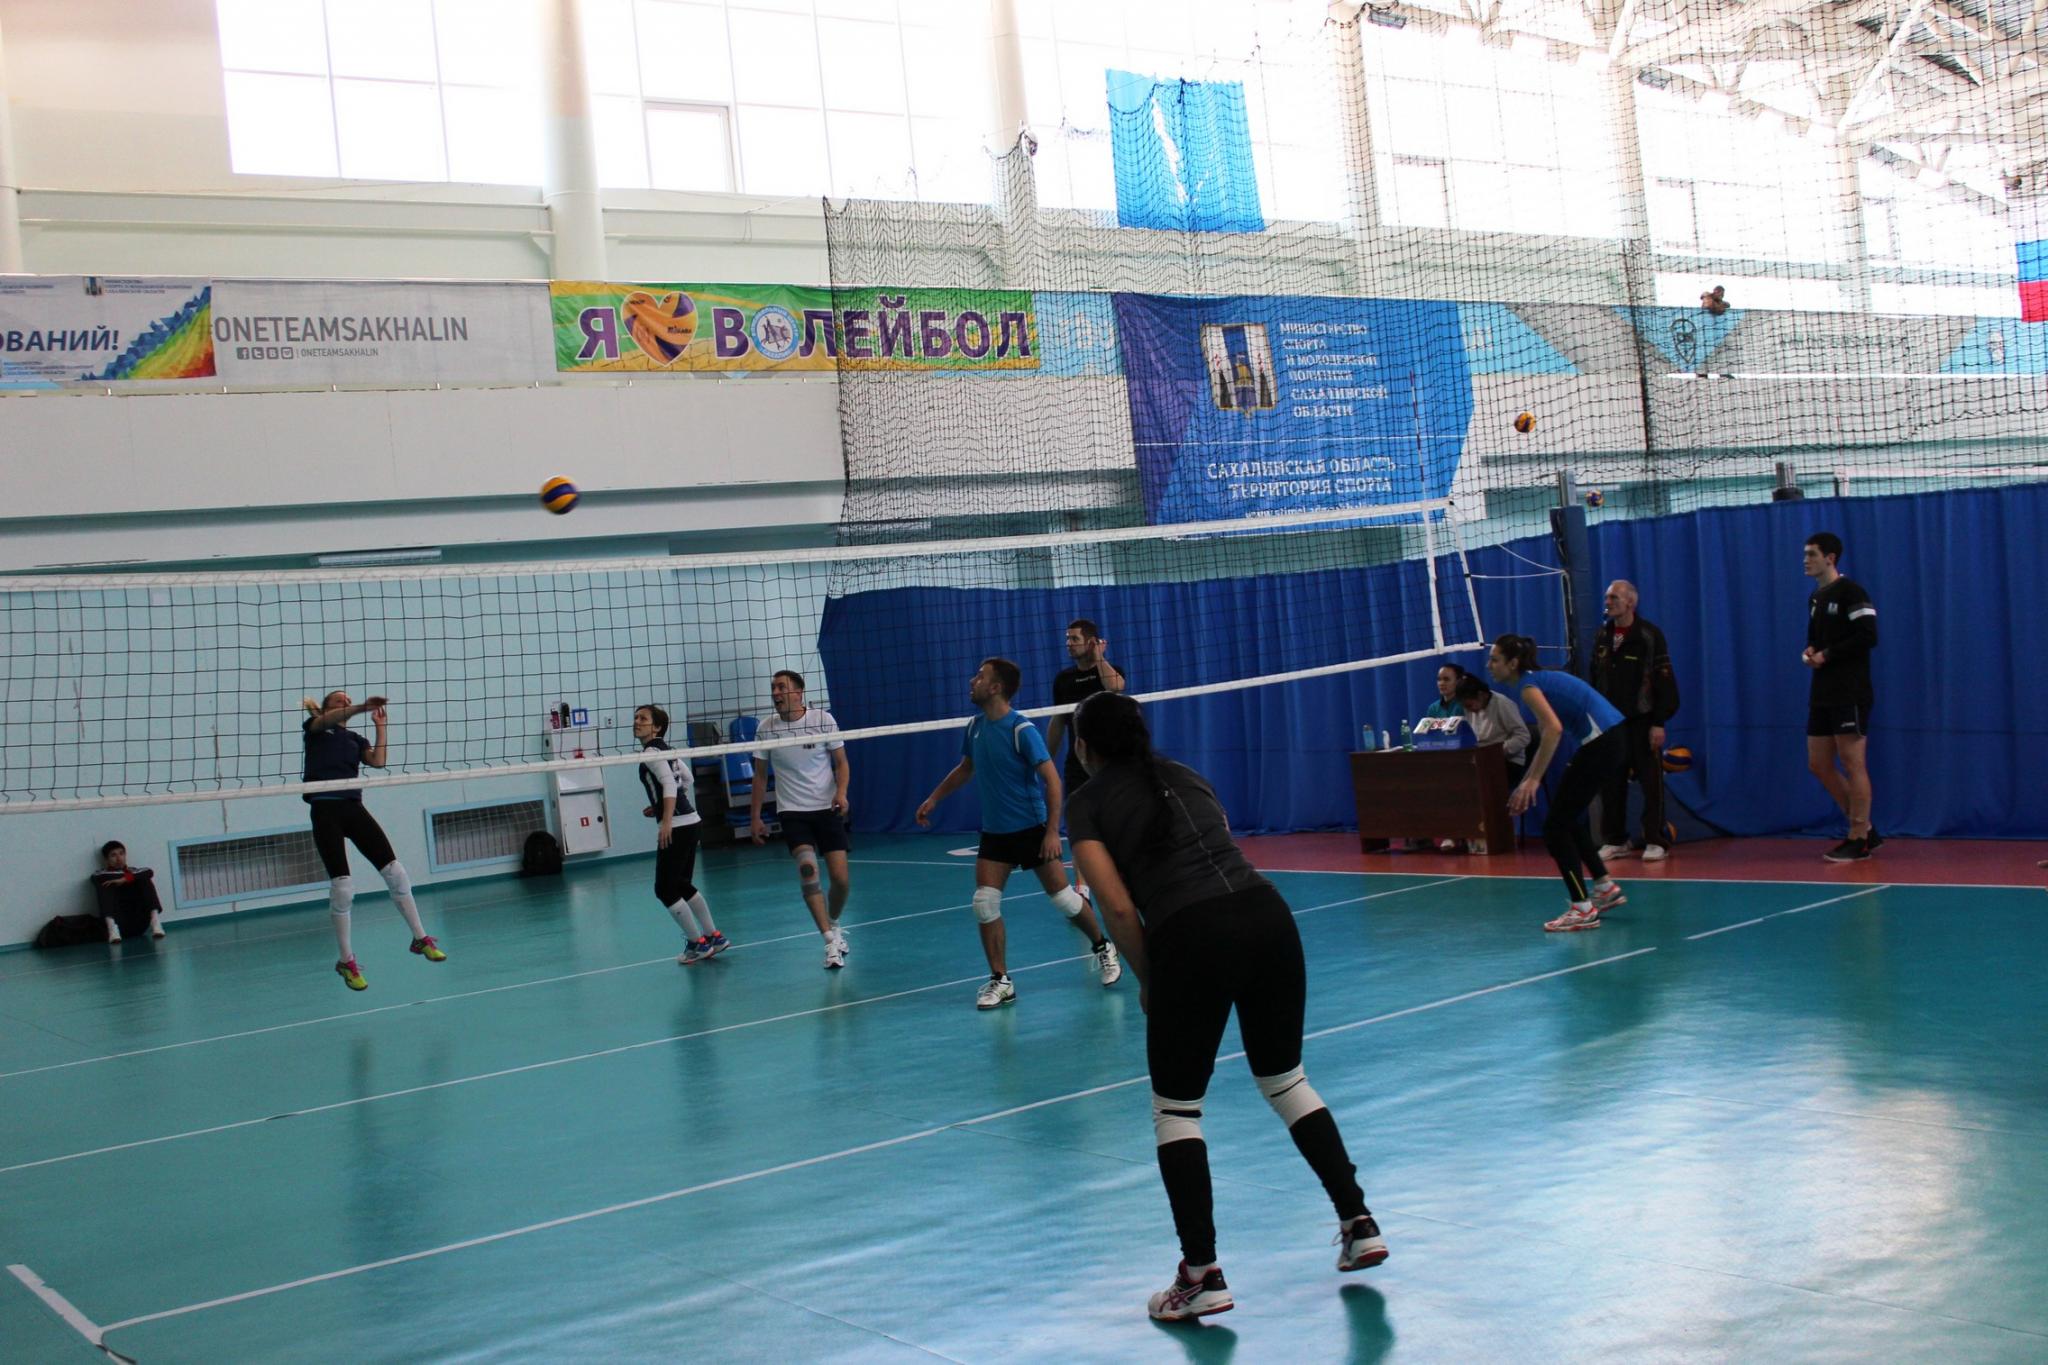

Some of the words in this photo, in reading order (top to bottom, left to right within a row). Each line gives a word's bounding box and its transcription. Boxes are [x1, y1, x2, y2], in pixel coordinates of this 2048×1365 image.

[0, 325, 119, 351] ВАНИЙ!
[576, 308, 620, 360] Я
[1207, 458, 1327, 480] САХАЛИНСКАЯ
[1329, 456, 1397, 475] ОБЛАСТЬ
[1228, 479, 1331, 500] ТЕРРИТОРИЯ
[1333, 477, 1393, 494] СПОРТА
